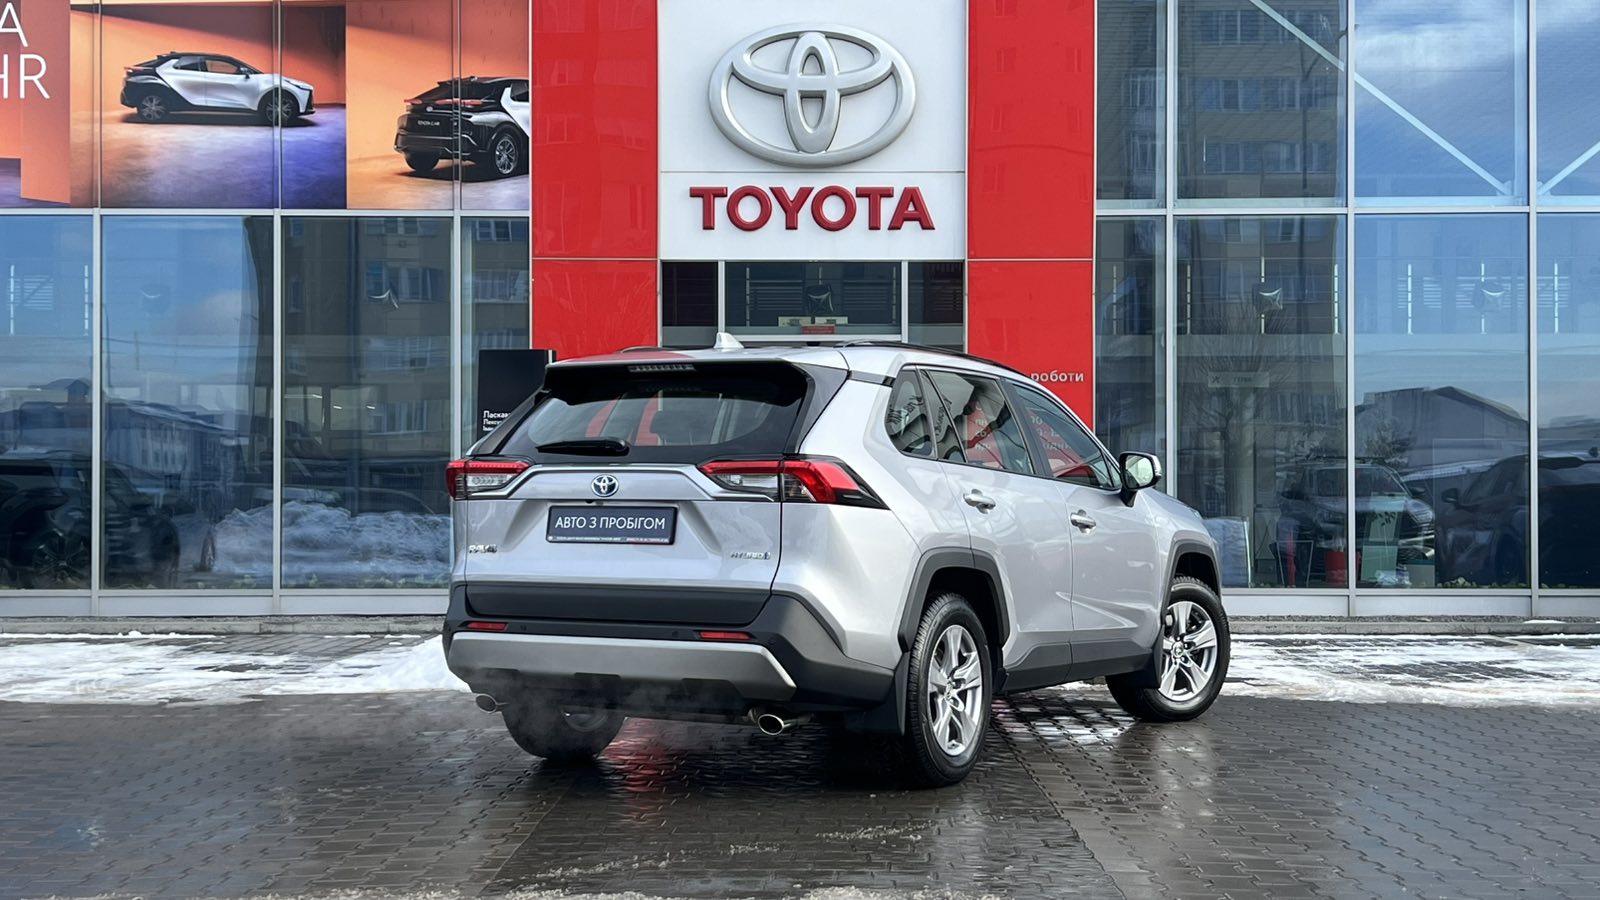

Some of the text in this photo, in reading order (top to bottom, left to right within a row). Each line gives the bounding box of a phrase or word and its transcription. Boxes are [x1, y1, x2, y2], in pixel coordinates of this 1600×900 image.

[0, 53, 50, 99] R
[689, 185, 936, 231] TOYOTA
[1030, 370, 1085, 382] роботи
[555, 516, 586, 529] АВТО
[599, 517, 666, 530] ПРОБІГОМ
